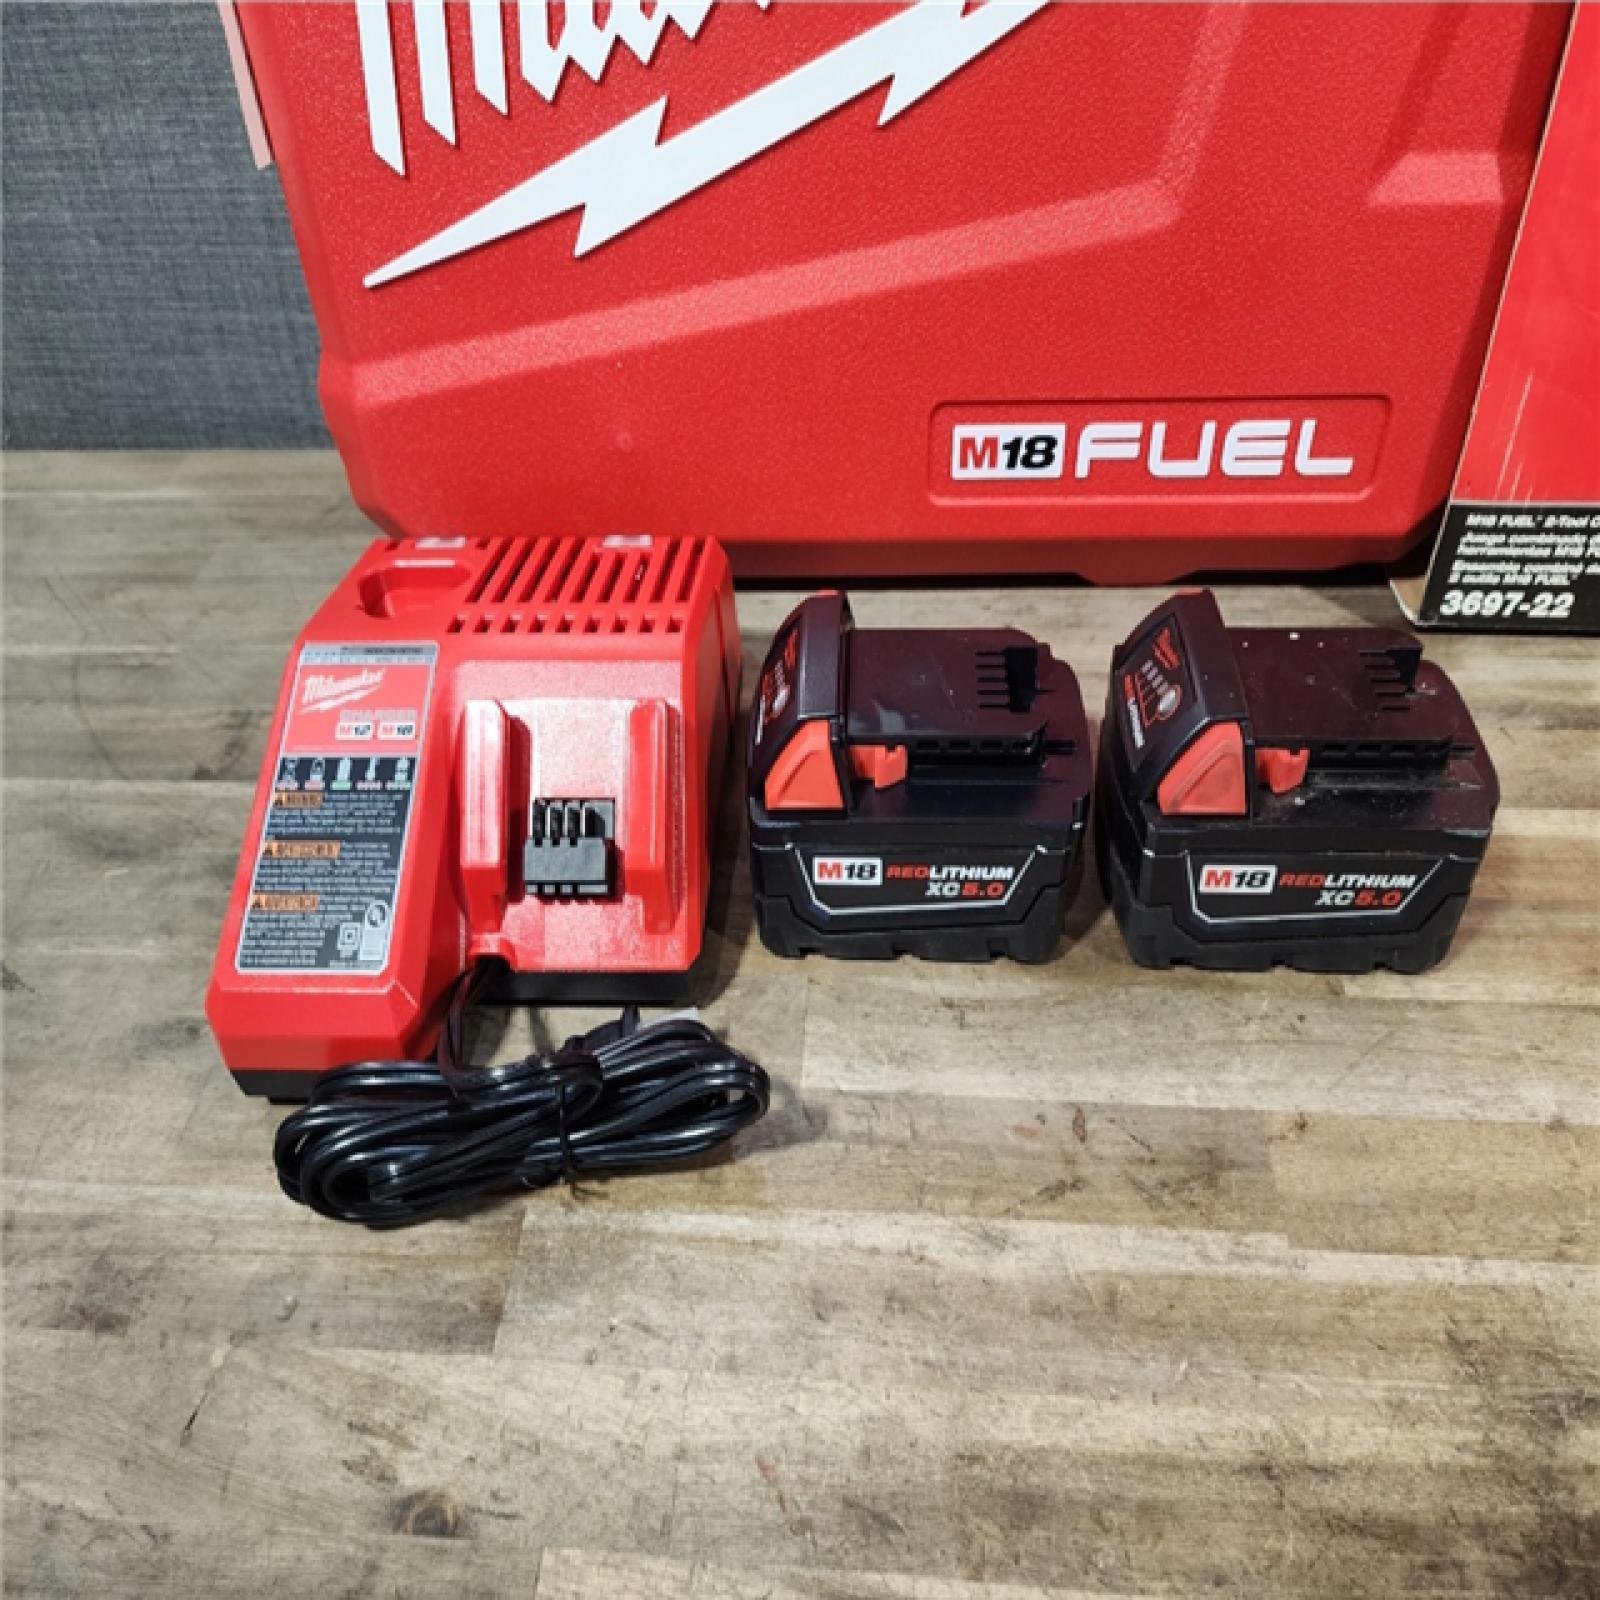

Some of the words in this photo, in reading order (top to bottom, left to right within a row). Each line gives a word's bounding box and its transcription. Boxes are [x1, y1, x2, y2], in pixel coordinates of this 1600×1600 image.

[958, 434, 1057, 469] M18
[1075, 418, 1355, 479] FUEL
[1440, 590, 1576, 618] 3697-22
[817, 861, 879, 881] M18
[1204, 869, 1271, 889] M18
